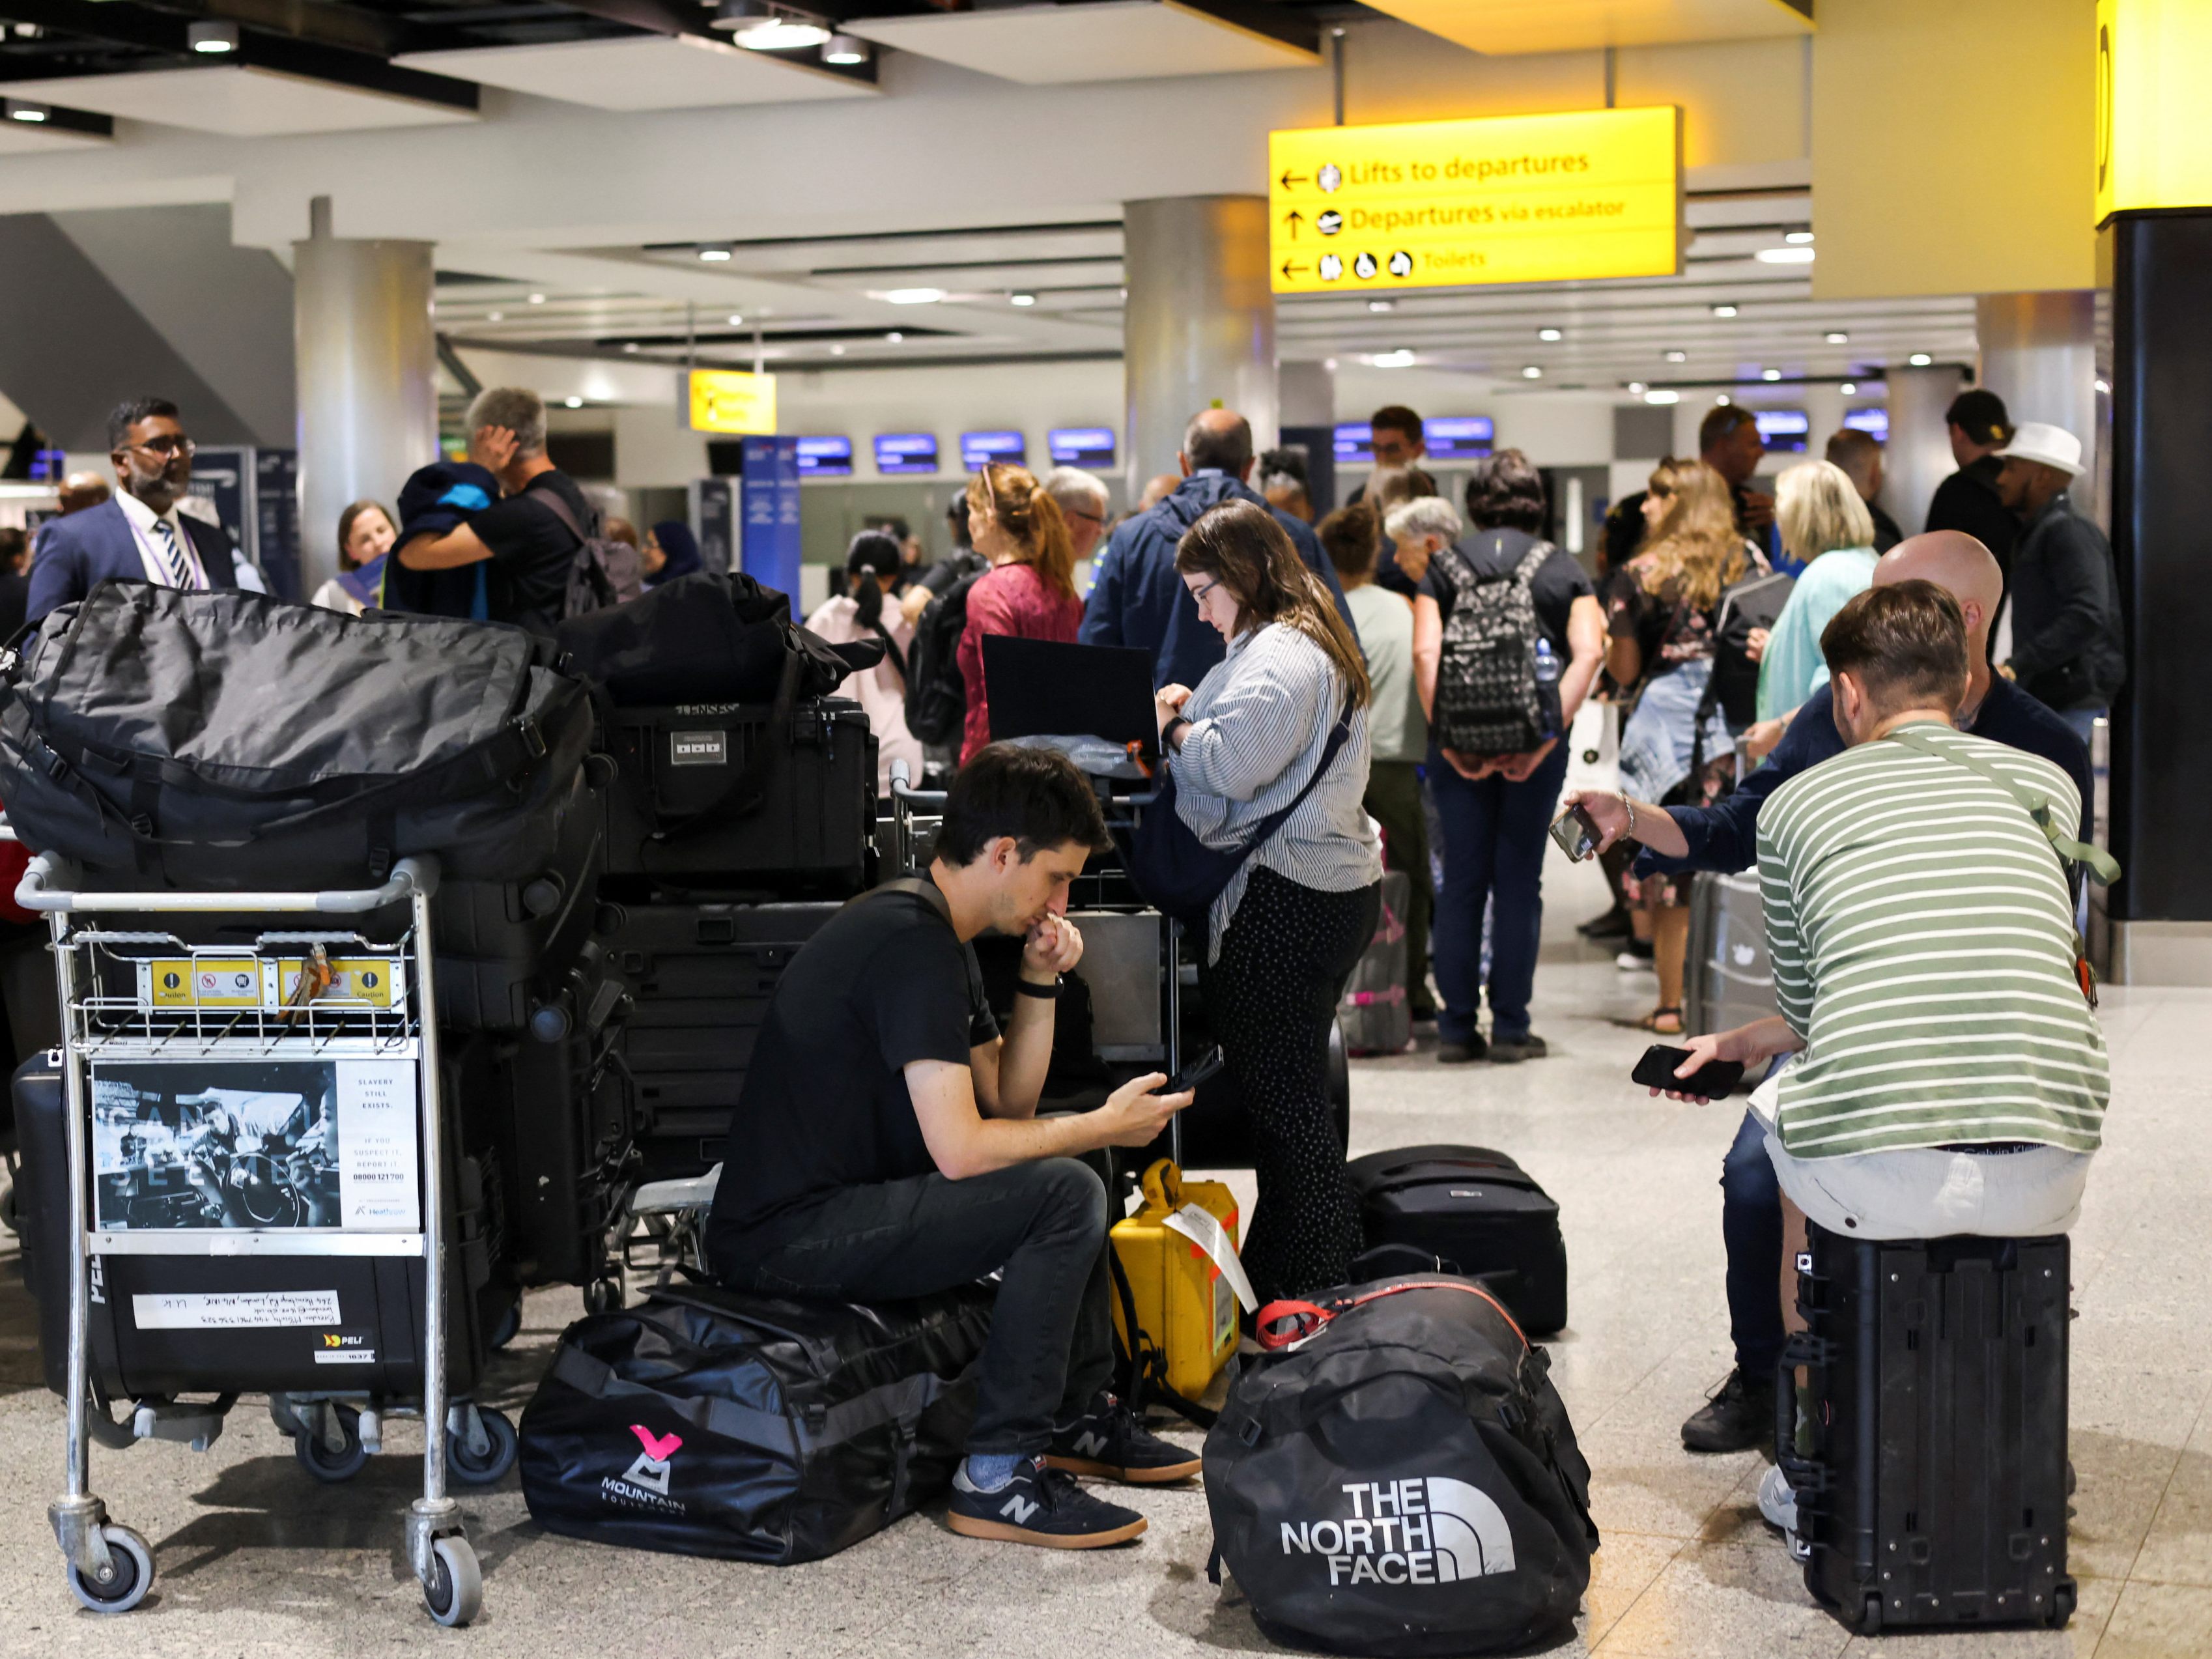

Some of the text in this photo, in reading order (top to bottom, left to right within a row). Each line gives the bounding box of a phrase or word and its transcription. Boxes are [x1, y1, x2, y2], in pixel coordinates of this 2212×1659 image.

[1350, 153, 1589, 186] Lifts to departures
[1350, 201, 1626, 233] Departures via escalator
[1424, 252, 1486, 269] Toilets
[108, 1107, 203, 1135] CAN
[342, 1337, 363, 1345] PELI
[601, 1475, 687, 1512] MOUNTAIN
[1342, 1478, 1426, 1519] THE
[1281, 1514, 1432, 1555] NORTH
[1327, 1550, 1436, 1586] FACE
